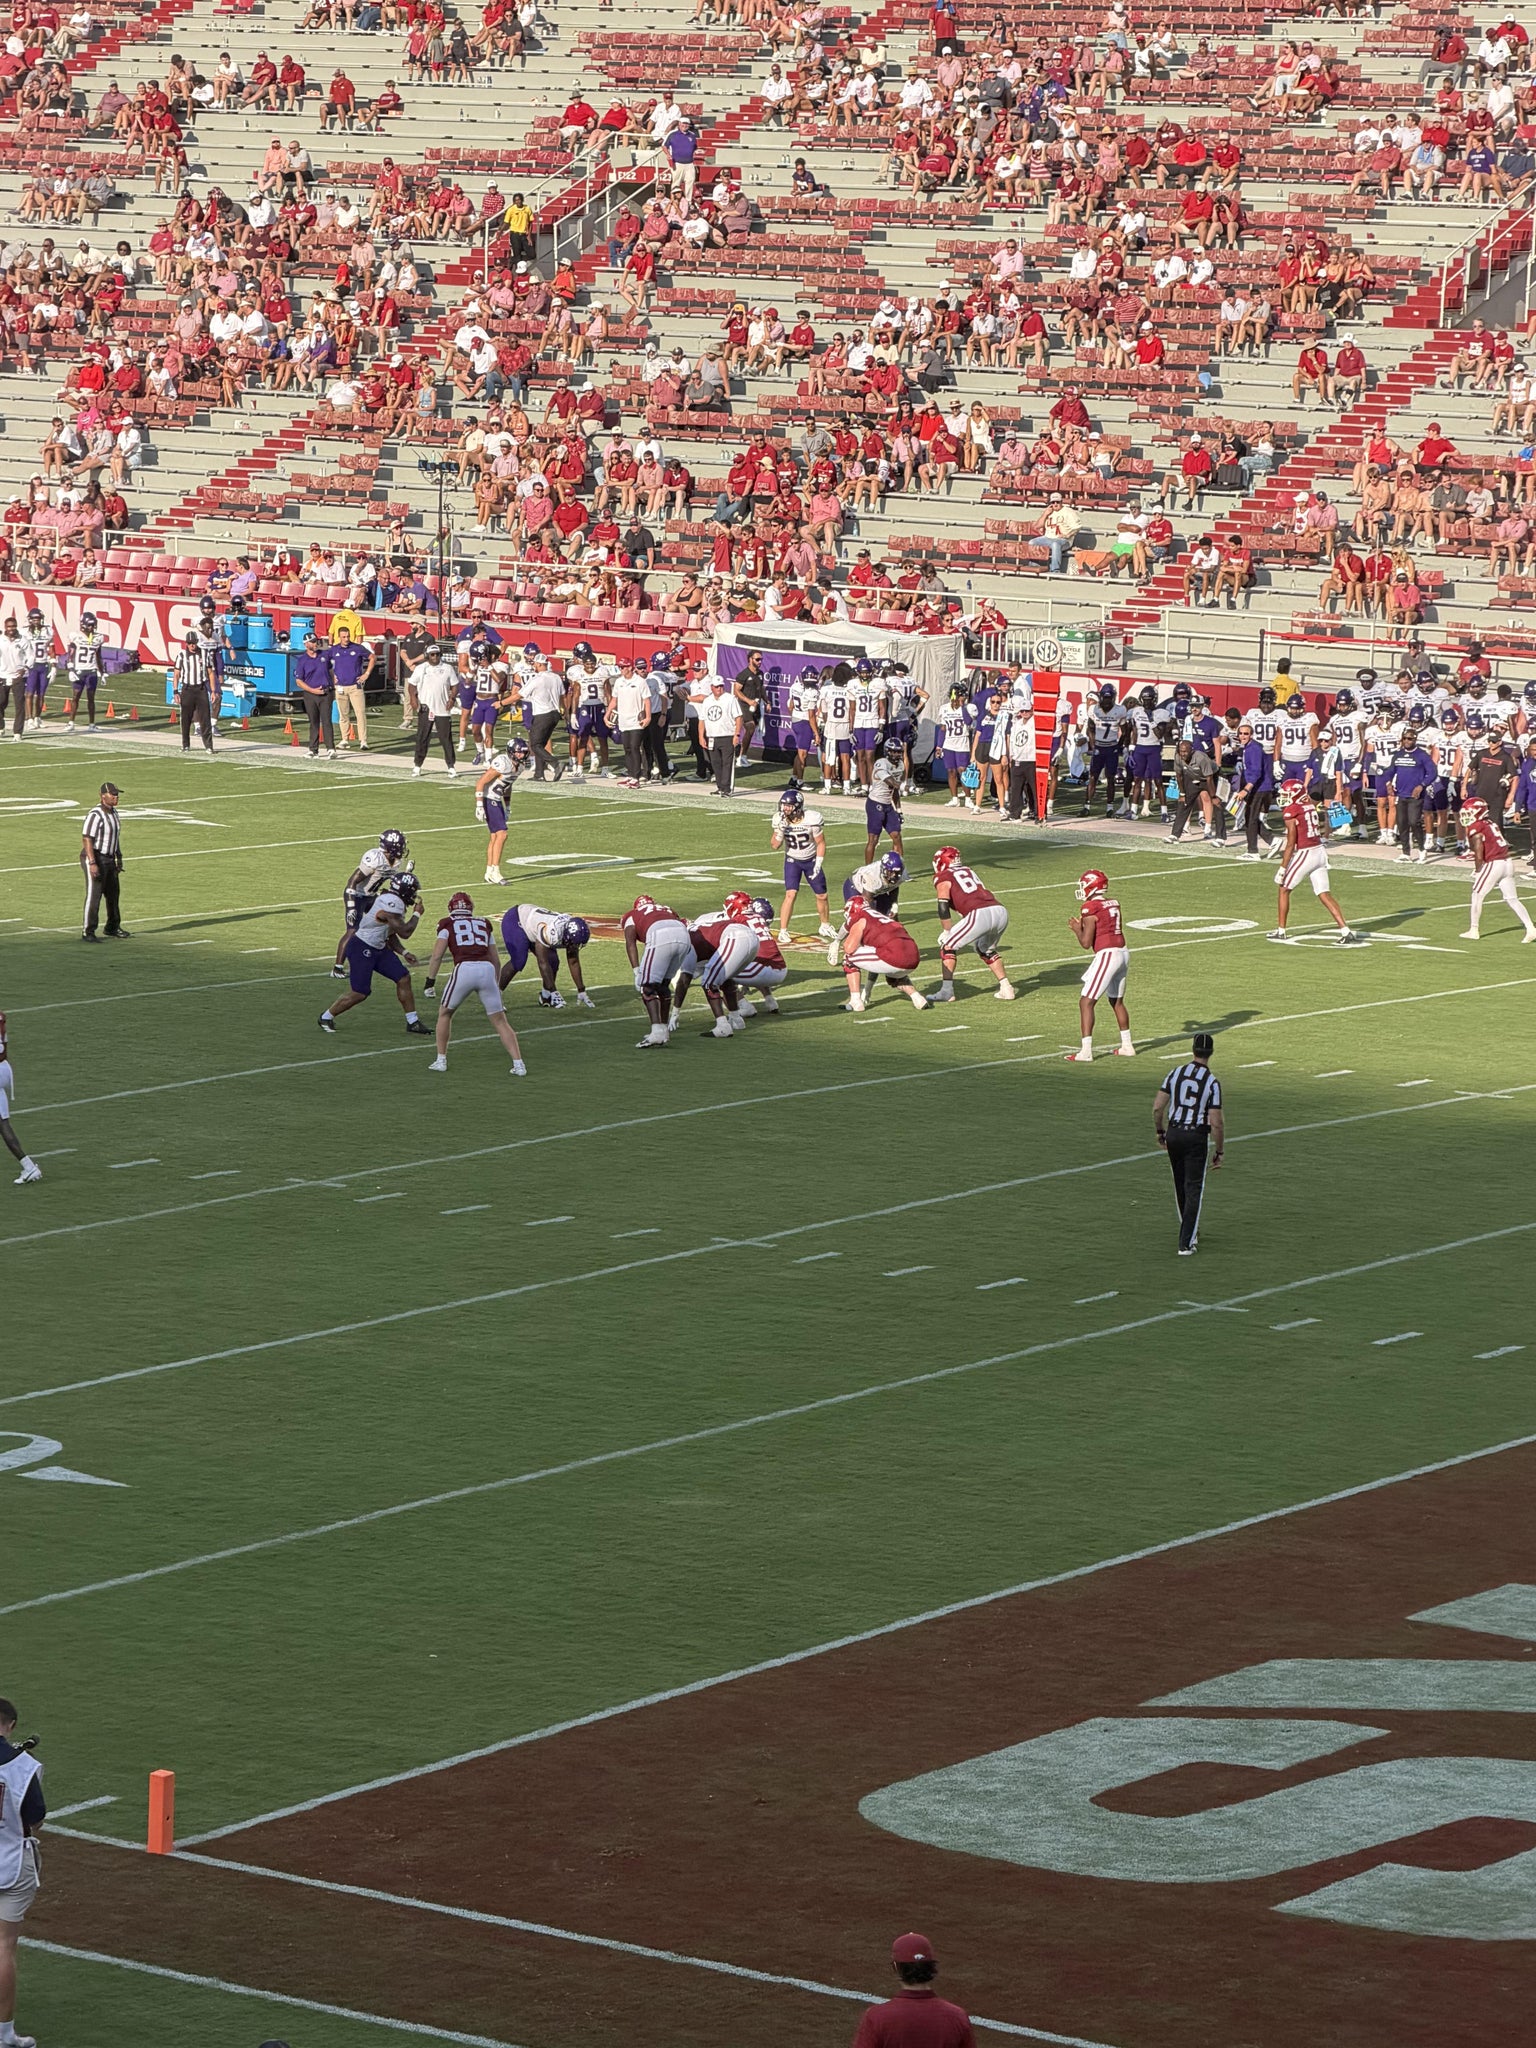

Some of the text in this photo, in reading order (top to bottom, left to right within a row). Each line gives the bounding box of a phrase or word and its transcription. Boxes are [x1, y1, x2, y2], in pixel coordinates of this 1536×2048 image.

[78, 646, 96, 664] 27
[1037, 640, 1057, 661] SEC
[479, 673, 492, 692] 21
[763, 671, 791, 684] ORTH
[587, 684, 598, 699] 9
[833, 697, 846, 718] 8
[859, 695, 872, 712] 81
[708, 706, 722, 721] SEC
[770, 719, 792, 728] CLIN
[945, 719, 964, 736] 48
[1100, 723, 1112, 739] 7
[1254, 724, 1276, 741] 90
[1284, 728, 1307, 745] 94
[453, 919, 489, 947] 85
[1180, 1079, 1199, 1107] C
